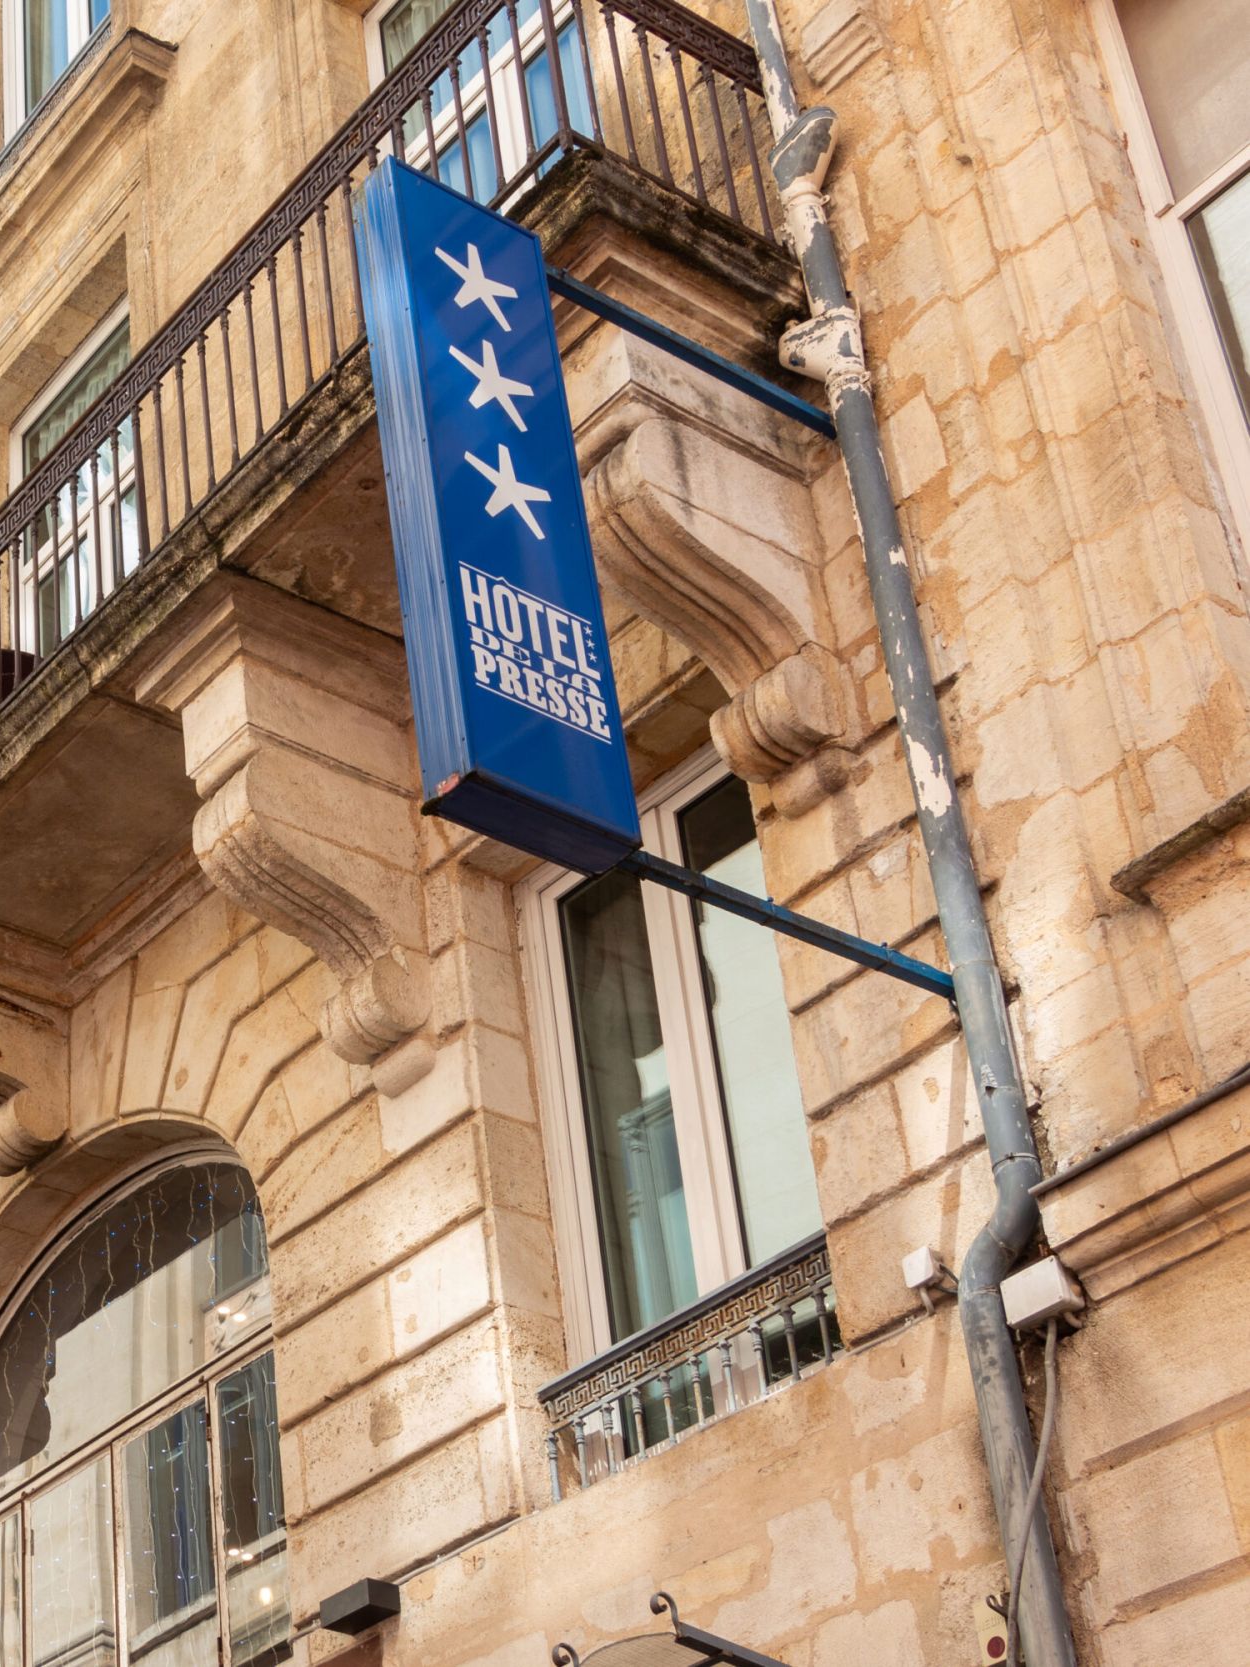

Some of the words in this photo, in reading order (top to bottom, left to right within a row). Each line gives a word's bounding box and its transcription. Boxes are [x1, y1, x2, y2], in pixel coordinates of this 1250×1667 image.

[469, 624, 531, 667] DE
[539, 655, 604, 700] LA
[471, 644, 611, 739] PRESSE
